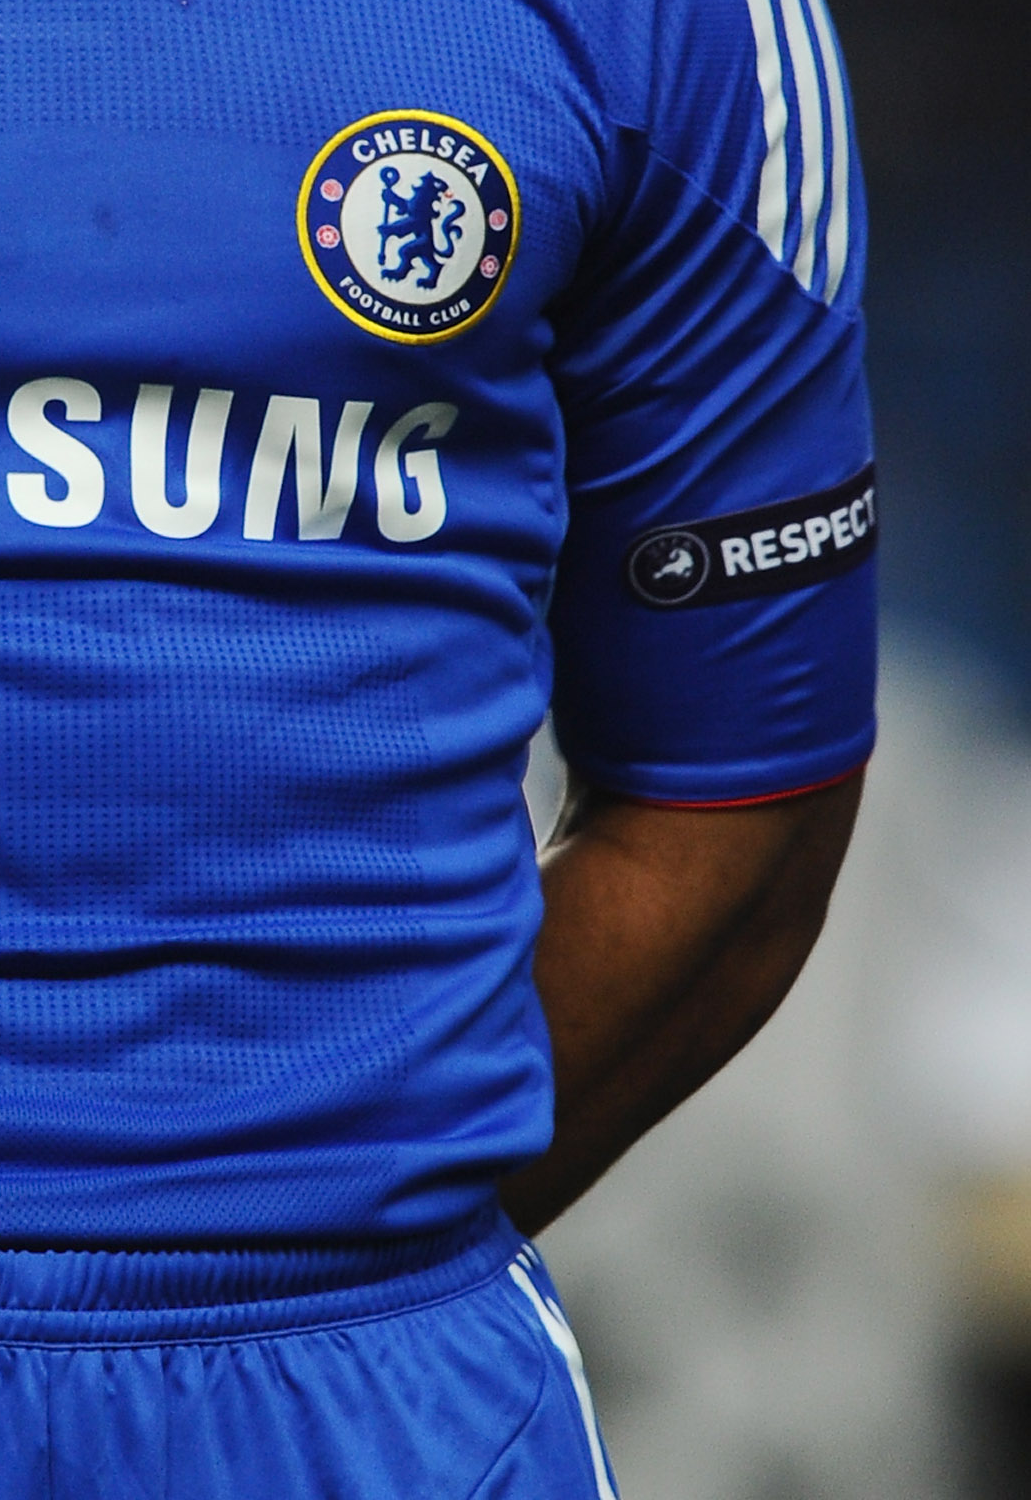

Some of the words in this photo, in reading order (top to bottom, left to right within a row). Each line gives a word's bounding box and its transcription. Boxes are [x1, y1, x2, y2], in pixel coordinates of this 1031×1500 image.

[351, 127, 490, 188] CHELSEA
[339, 275, 421, 327] FOOTBALL
[429, 298, 471, 326] CLUB
